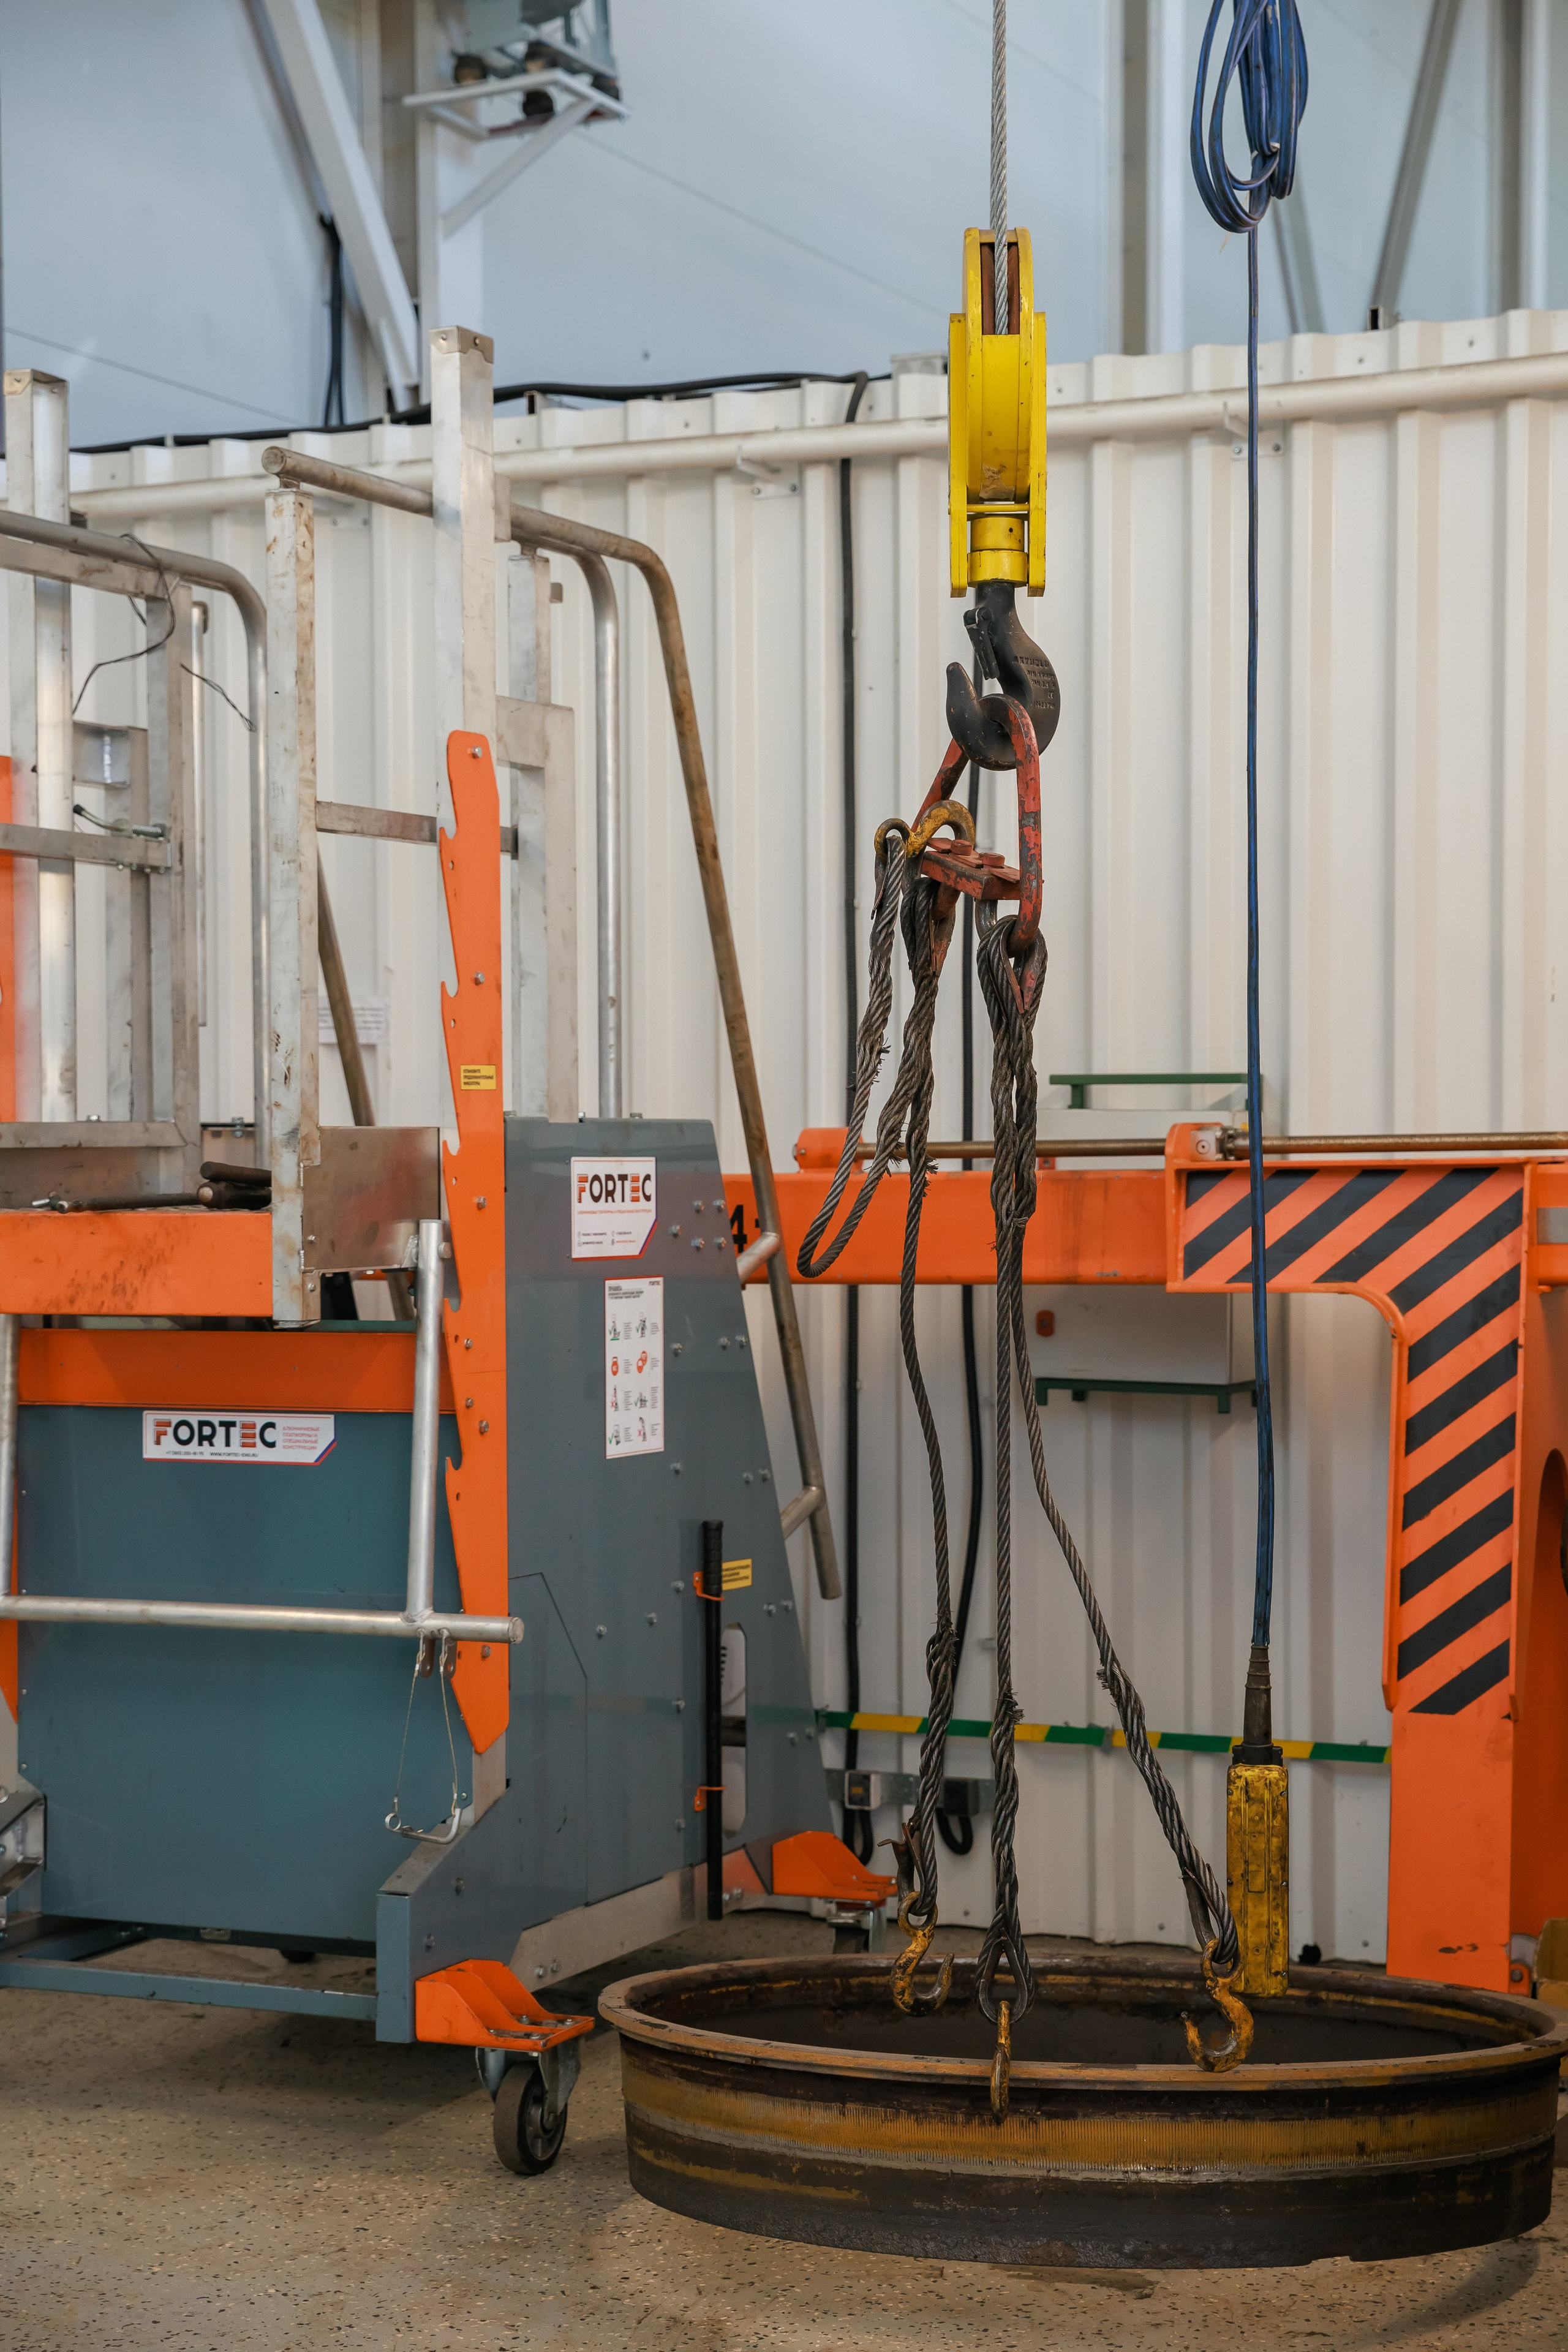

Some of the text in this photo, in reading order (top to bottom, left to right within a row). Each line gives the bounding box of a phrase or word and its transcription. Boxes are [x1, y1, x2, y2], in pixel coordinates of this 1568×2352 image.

[577, 1173, 651, 1204] FORTEC
[729, 1204, 747, 1254] 4
[153, 1418, 276, 1449] FORTEC
